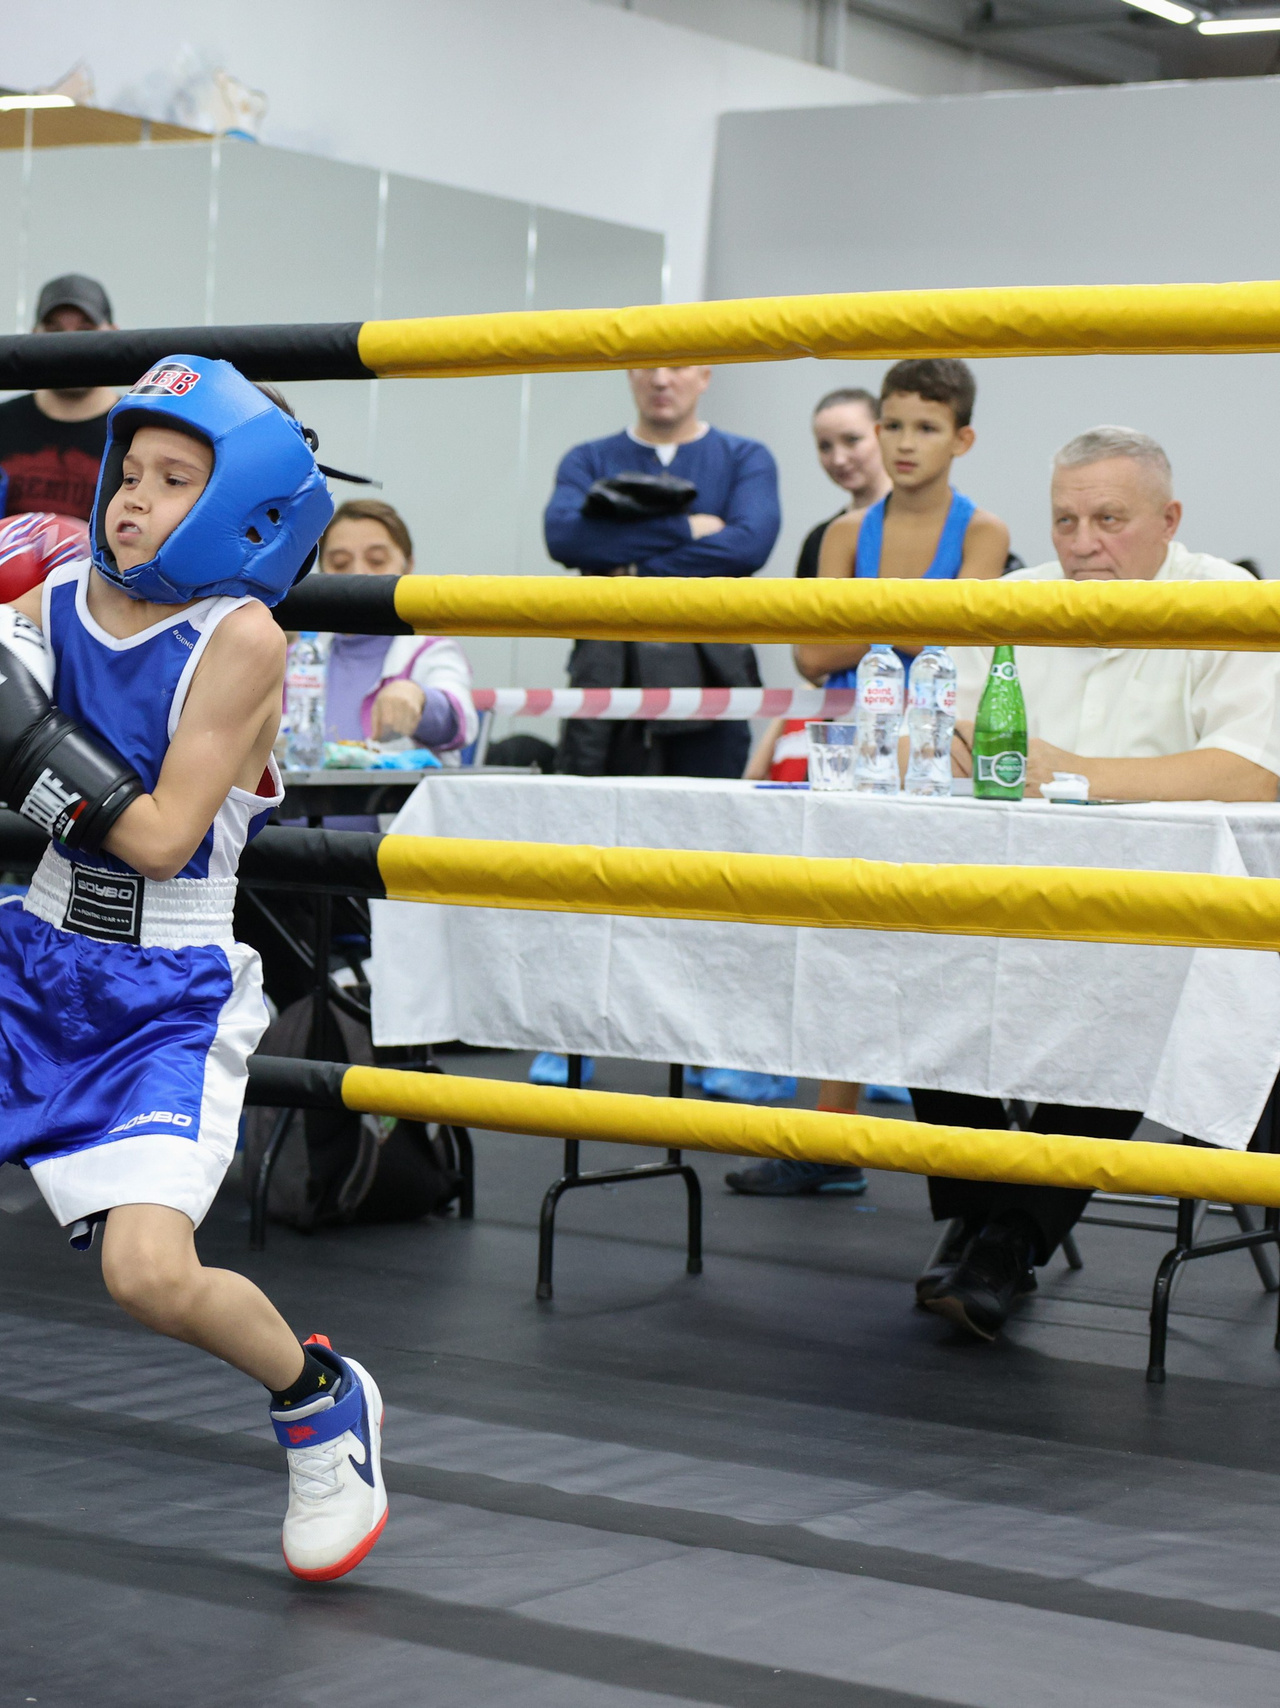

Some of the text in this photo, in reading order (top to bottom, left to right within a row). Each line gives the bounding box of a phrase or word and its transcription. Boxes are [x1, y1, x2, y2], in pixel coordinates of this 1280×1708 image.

[172, 629, 195, 650] BOXING
[864, 696, 895, 706] spring
[866, 687, 892, 695] saint
[77, 879, 133, 901] BOYBO
[107, 1110, 193, 1134] BOYBO
